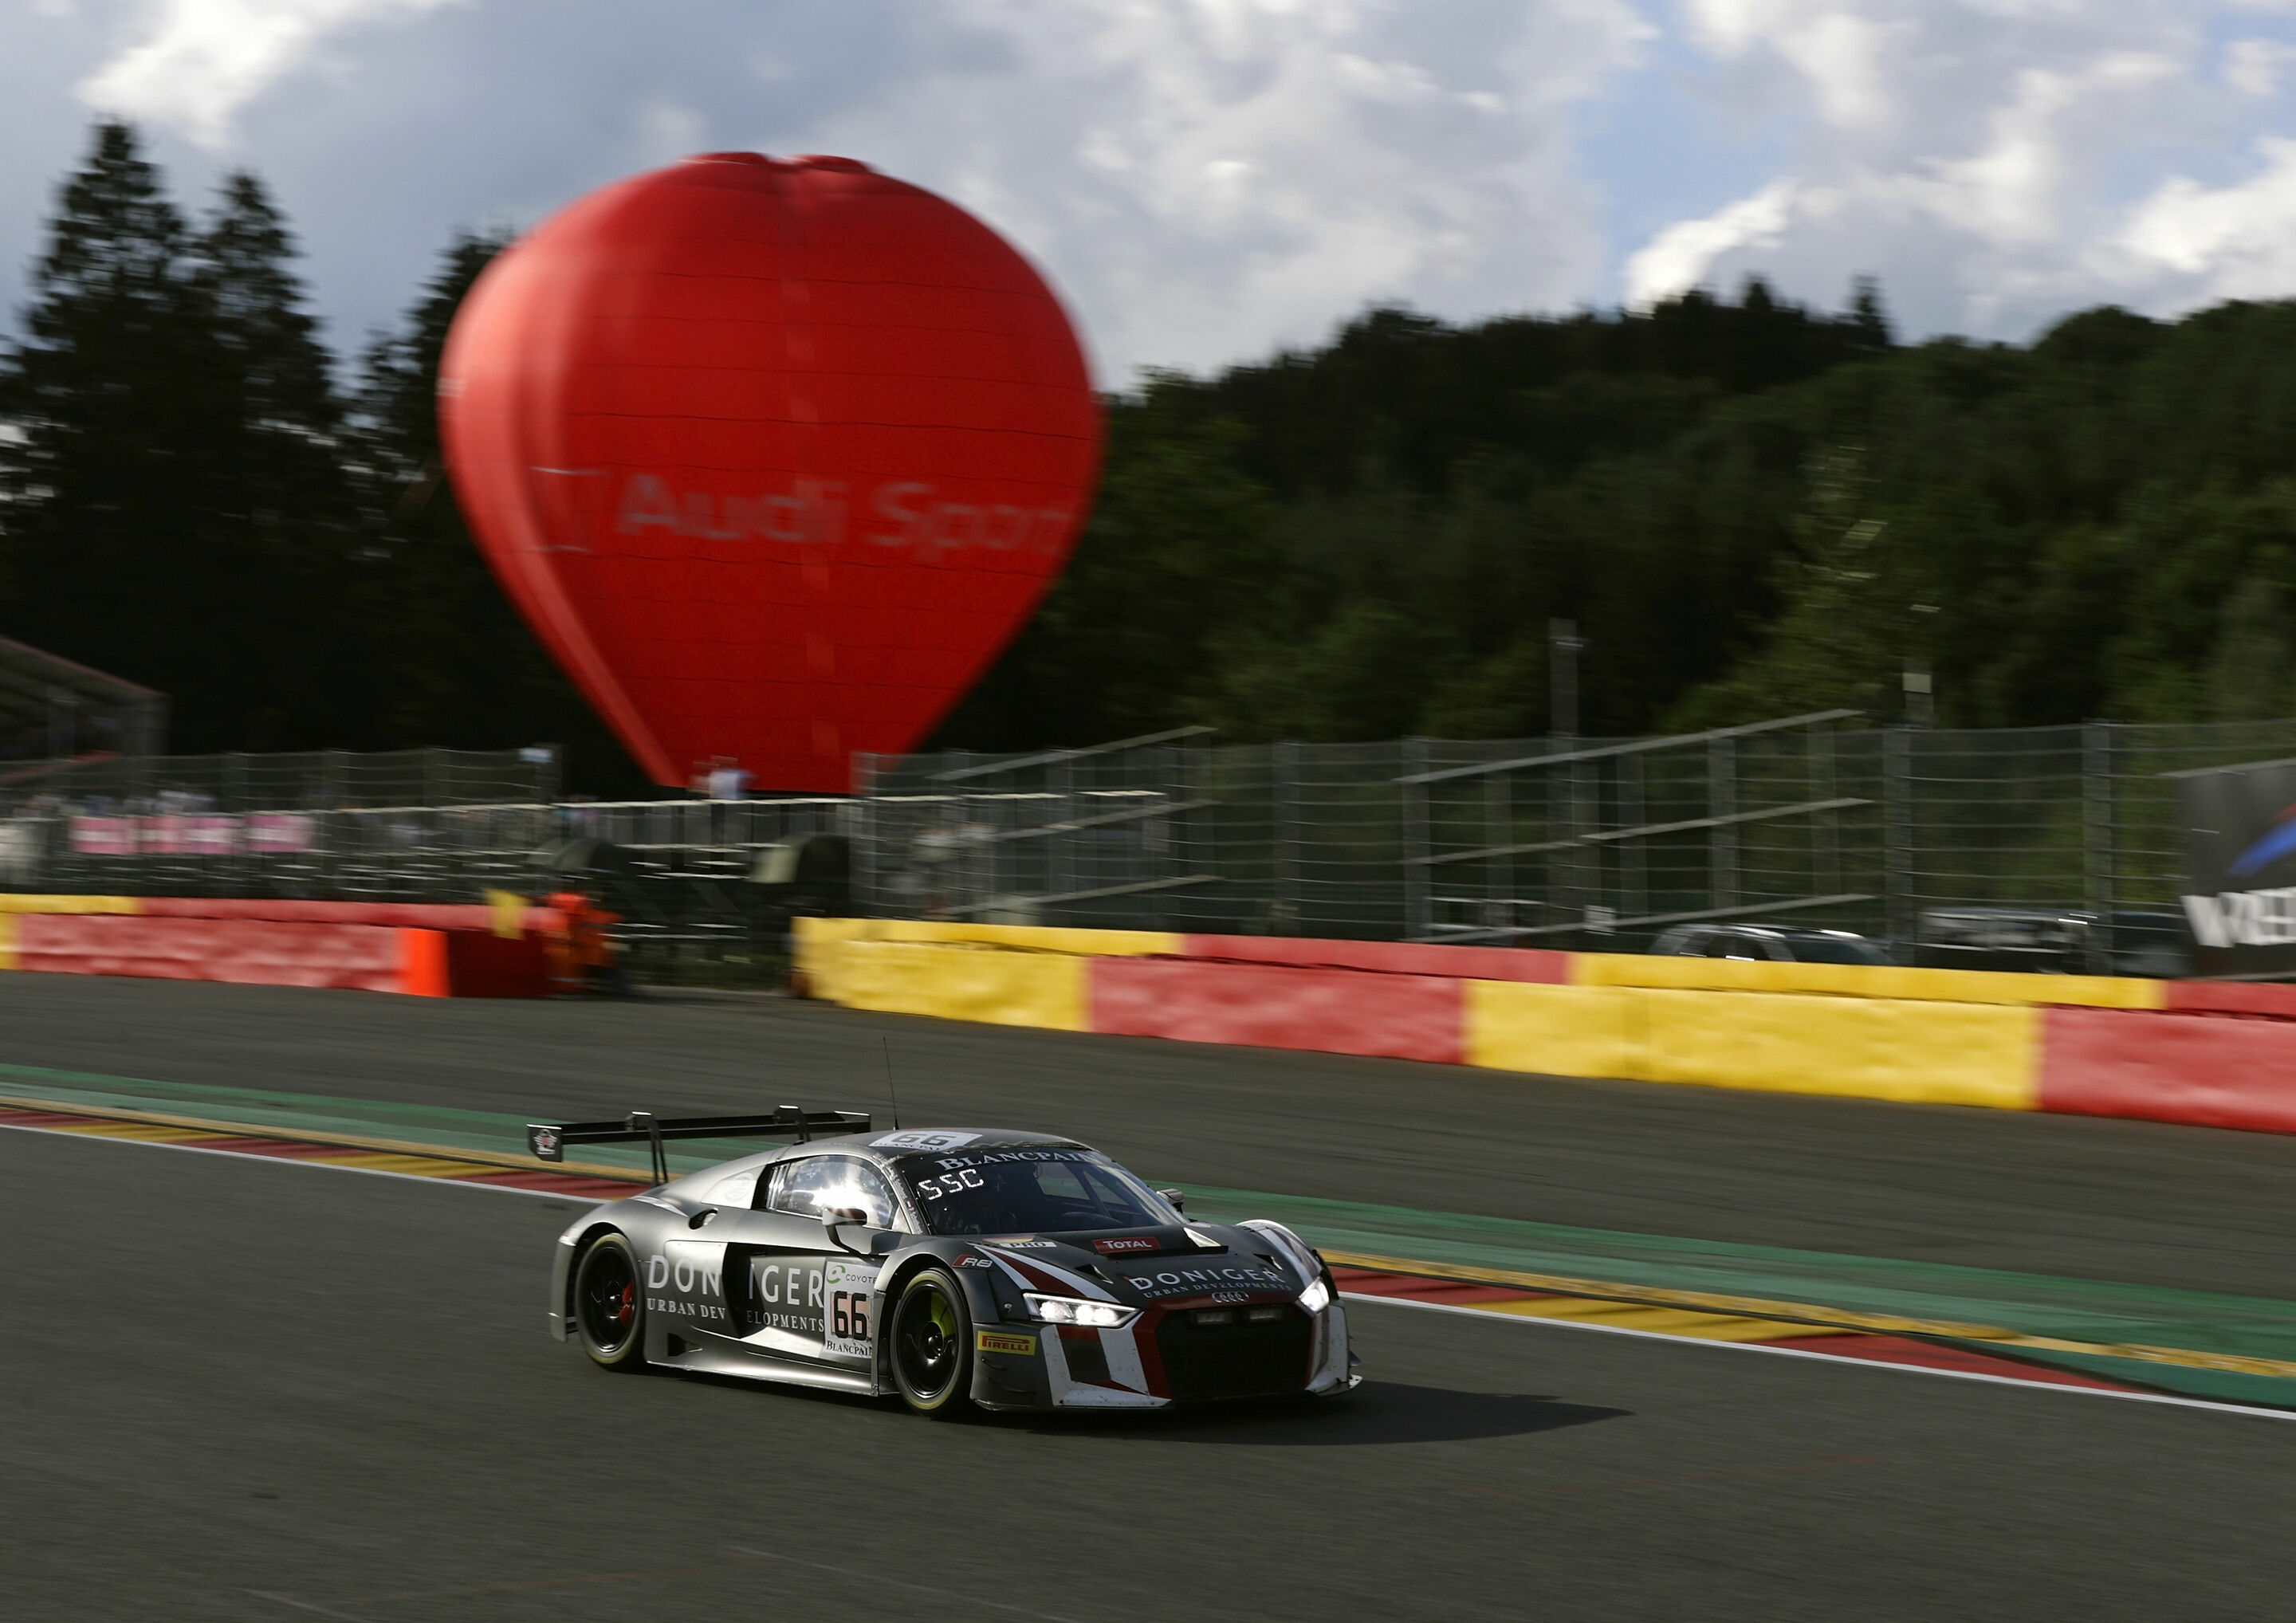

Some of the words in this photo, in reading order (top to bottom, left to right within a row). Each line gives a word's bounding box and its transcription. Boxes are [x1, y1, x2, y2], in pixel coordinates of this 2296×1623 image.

[615, 474, 848, 543] Audi
[890, 1134, 956, 1146] 66
[1102, 1240, 1153, 1249] TOTAL
[961, 1257, 993, 1267] R8
[845, 1274, 878, 1284] COYOTE
[1128, 1268, 1287, 1291] DONIGER
[1143, 1286, 1189, 1299] URBAN
[647, 1298, 697, 1316] URBAN
[833, 1290, 867, 1341] 66
[982, 1335, 1030, 1351] PIRELLI
